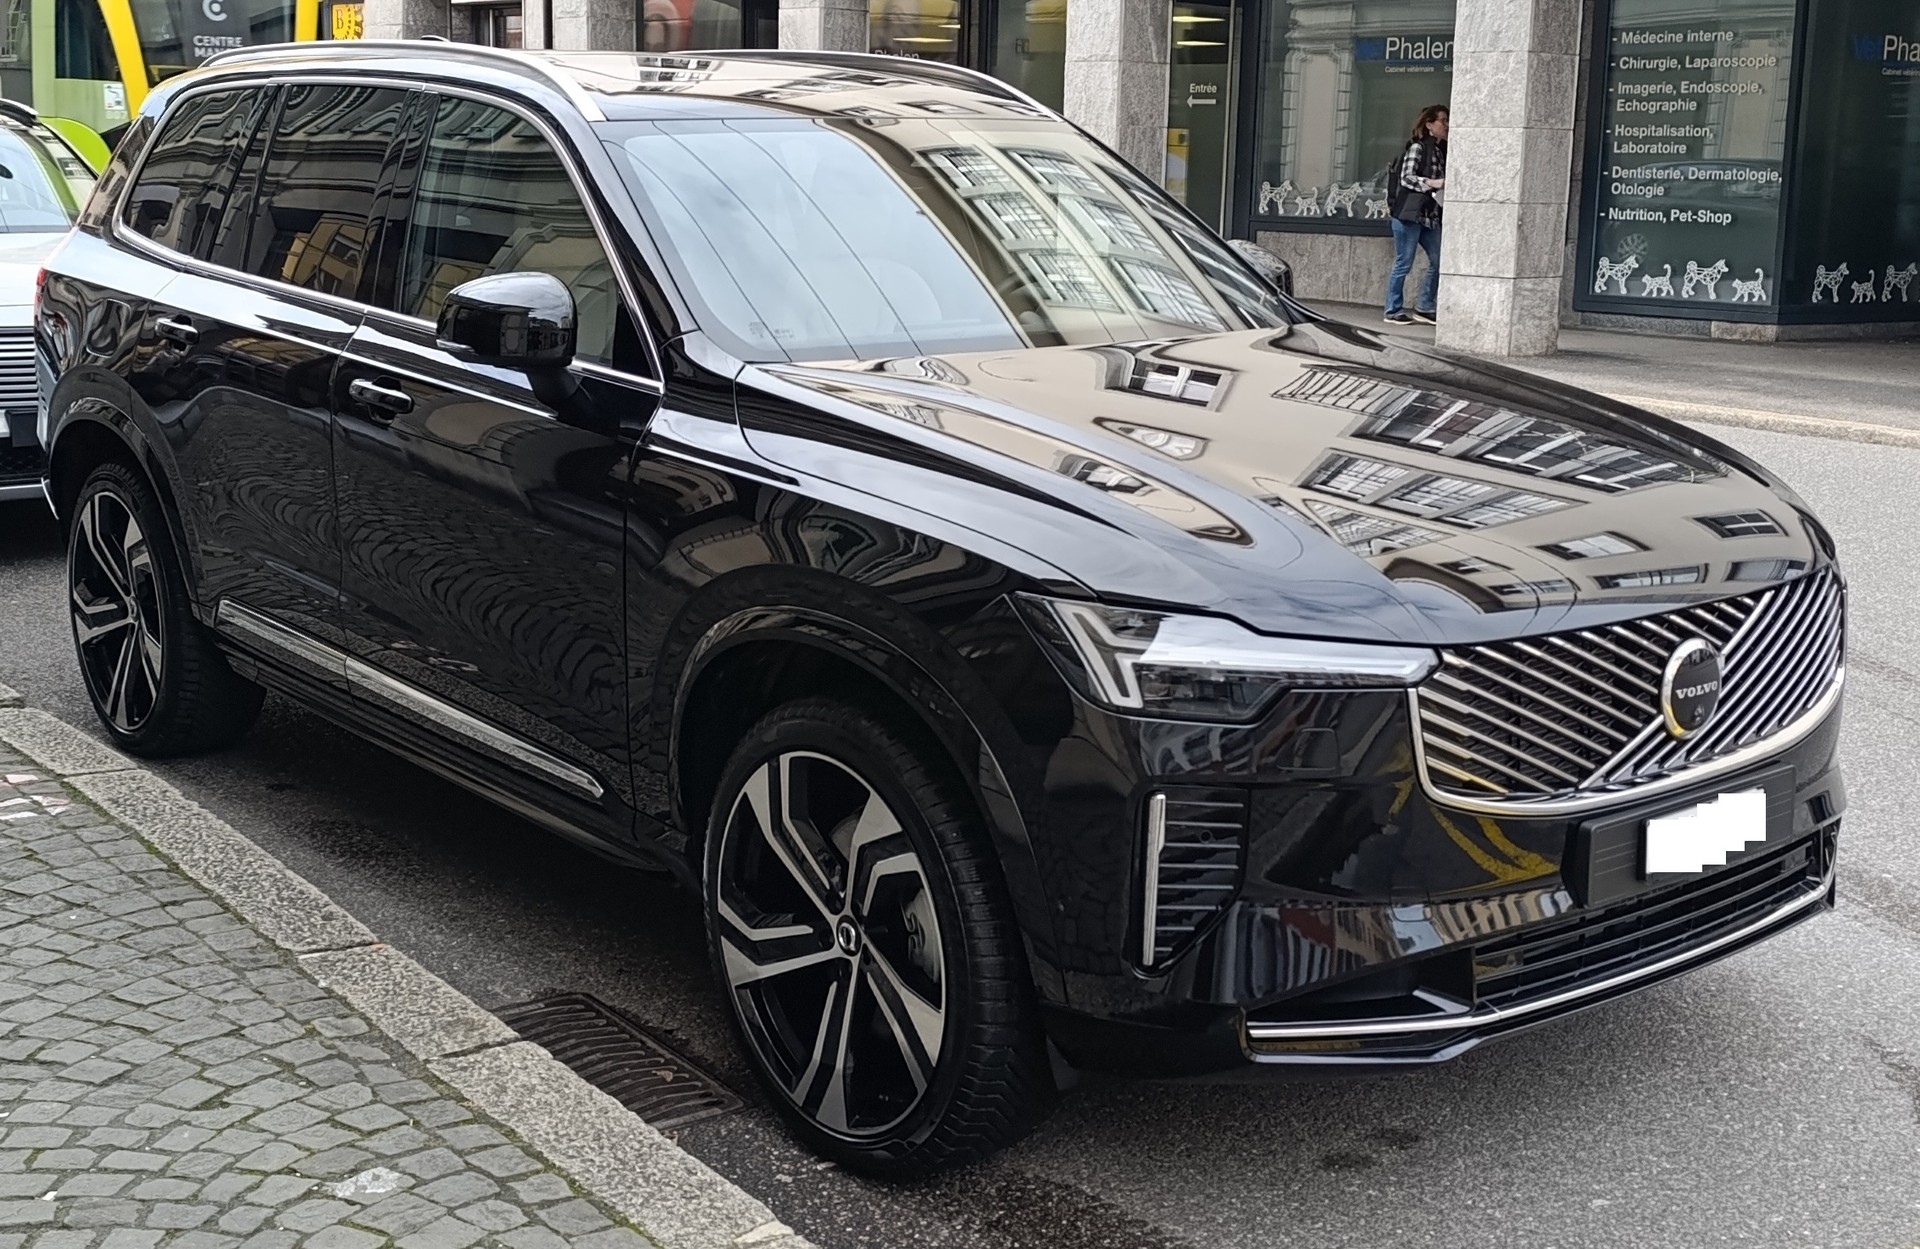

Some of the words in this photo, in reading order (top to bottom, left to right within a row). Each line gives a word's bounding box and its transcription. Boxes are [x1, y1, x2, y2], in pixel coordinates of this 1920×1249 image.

[193, 35, 243, 47] CENTRE
[1621, 31, 1684, 44] Médecine
[1687, 30, 1734, 42] interne
[1619, 57, 1682, 71] Chirurgie,
[1685, 54, 1777, 71] Laparoscopie
[1190, 82, 1217, 93] Entrée
[1617, 81, 1677, 97] Imagerie,
[1680, 80, 1763, 97] Endoscopie,
[1616, 99, 1697, 114] Echographie
[1614, 124, 1714, 139] Hospitalisation,
[1613, 141, 1687, 154] Laboratoire
[1611, 166, 1684, 181] Dentisterie,
[1688, 167, 1783, 183] Dermatologie,
[1611, 182, 1665, 198] Otologie
[1608, 207, 1667, 223] Nutrition,
[1670, 209, 1732, 226] Pet-Shop
[1675, 681, 1718, 699] VOLVO
